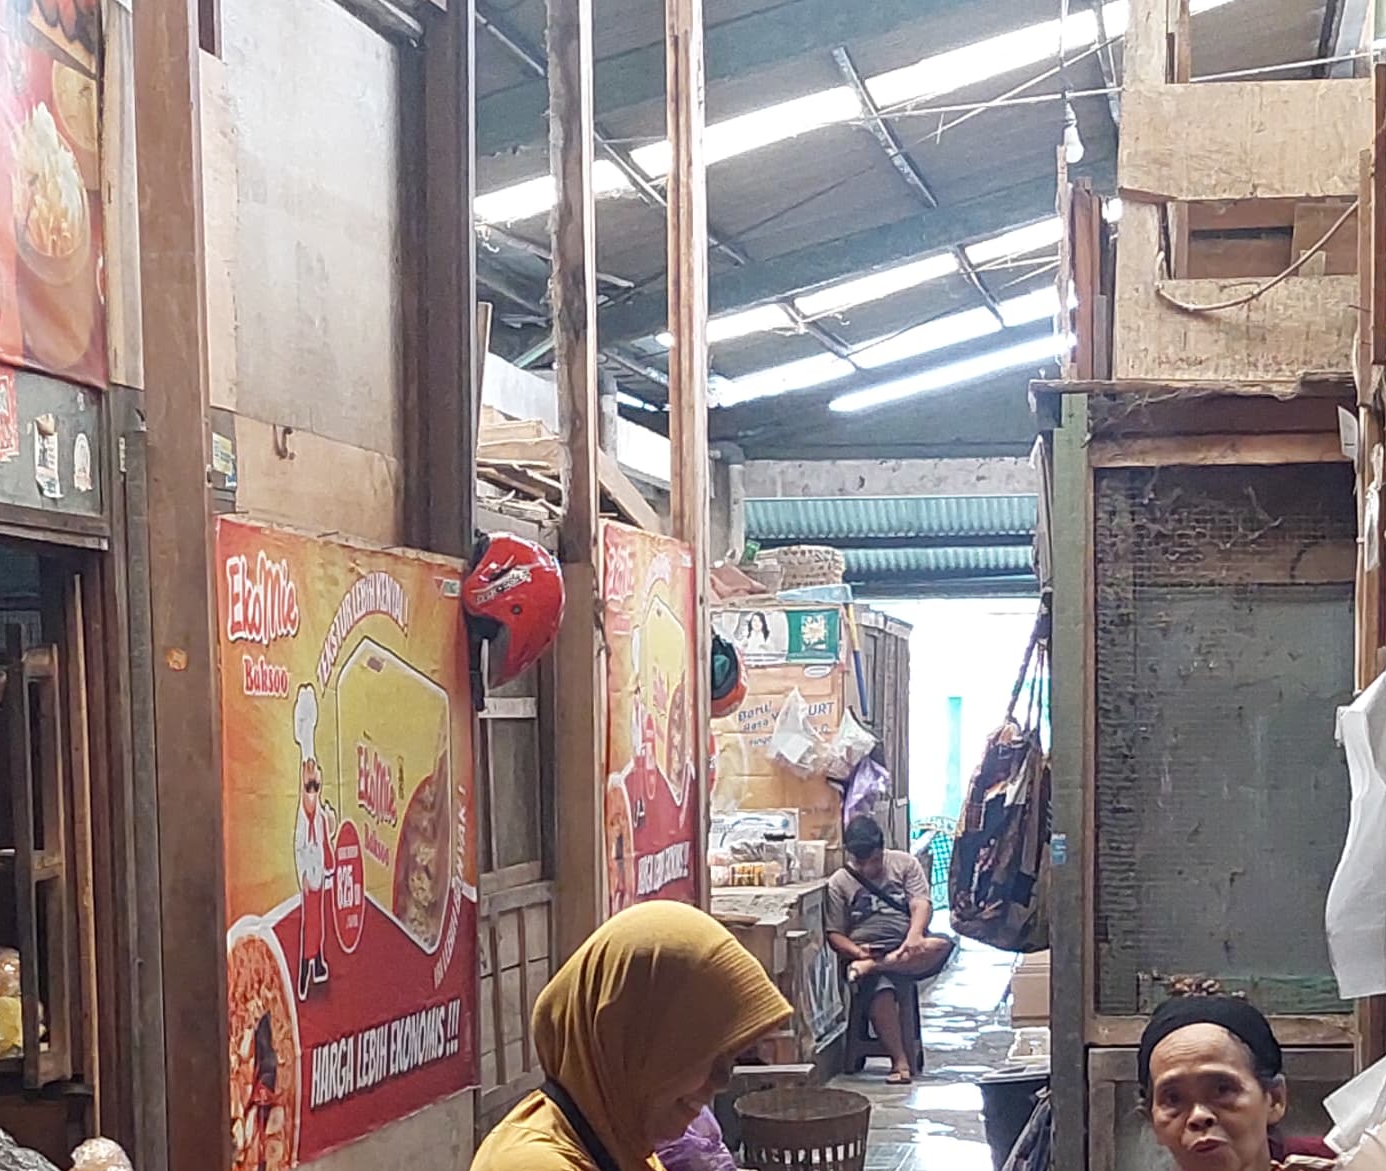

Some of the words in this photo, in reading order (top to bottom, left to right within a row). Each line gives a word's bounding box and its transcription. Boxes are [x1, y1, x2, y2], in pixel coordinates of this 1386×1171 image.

[227, 551, 299, 645] EkoMie
[242, 655, 288, 698] Baksoo
[310, 1035, 355, 1108] HARGA
[356, 1024, 389, 1089] LEBIH
[389, 1005, 445, 1076] EKONOMIS
